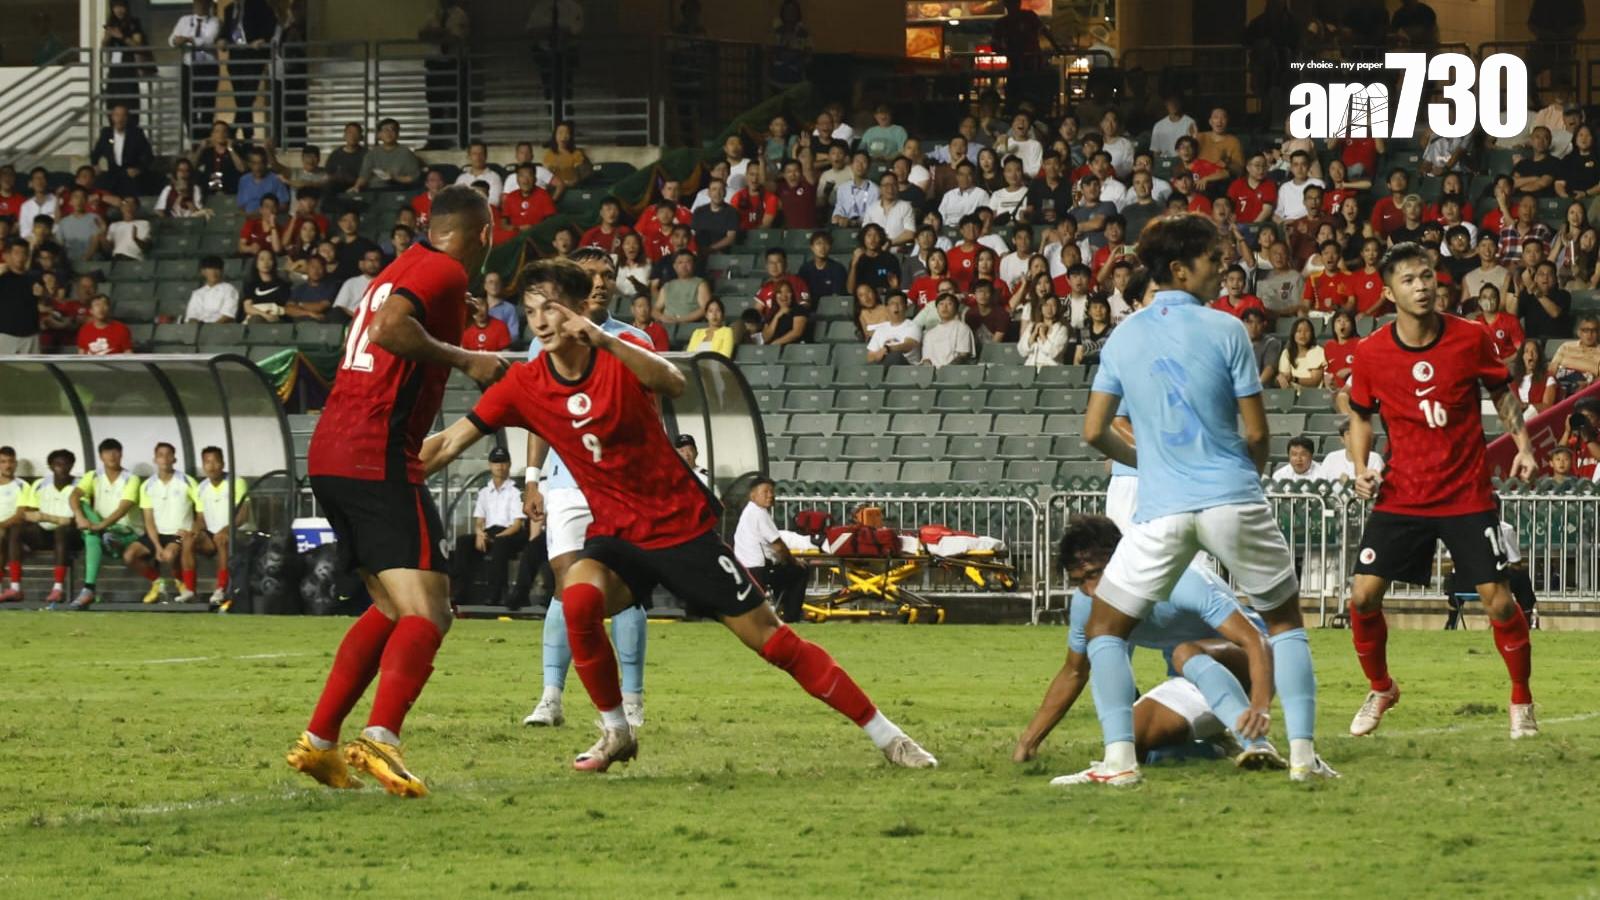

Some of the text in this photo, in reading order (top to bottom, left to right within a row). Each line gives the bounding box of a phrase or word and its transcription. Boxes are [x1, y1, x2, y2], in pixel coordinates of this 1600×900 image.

[1240, 200, 1247, 213] 7
[342, 282, 394, 373] 12
[1418, 399, 1448, 428] 16
[581, 433, 602, 463] 9
[718, 555, 743, 585] 9
